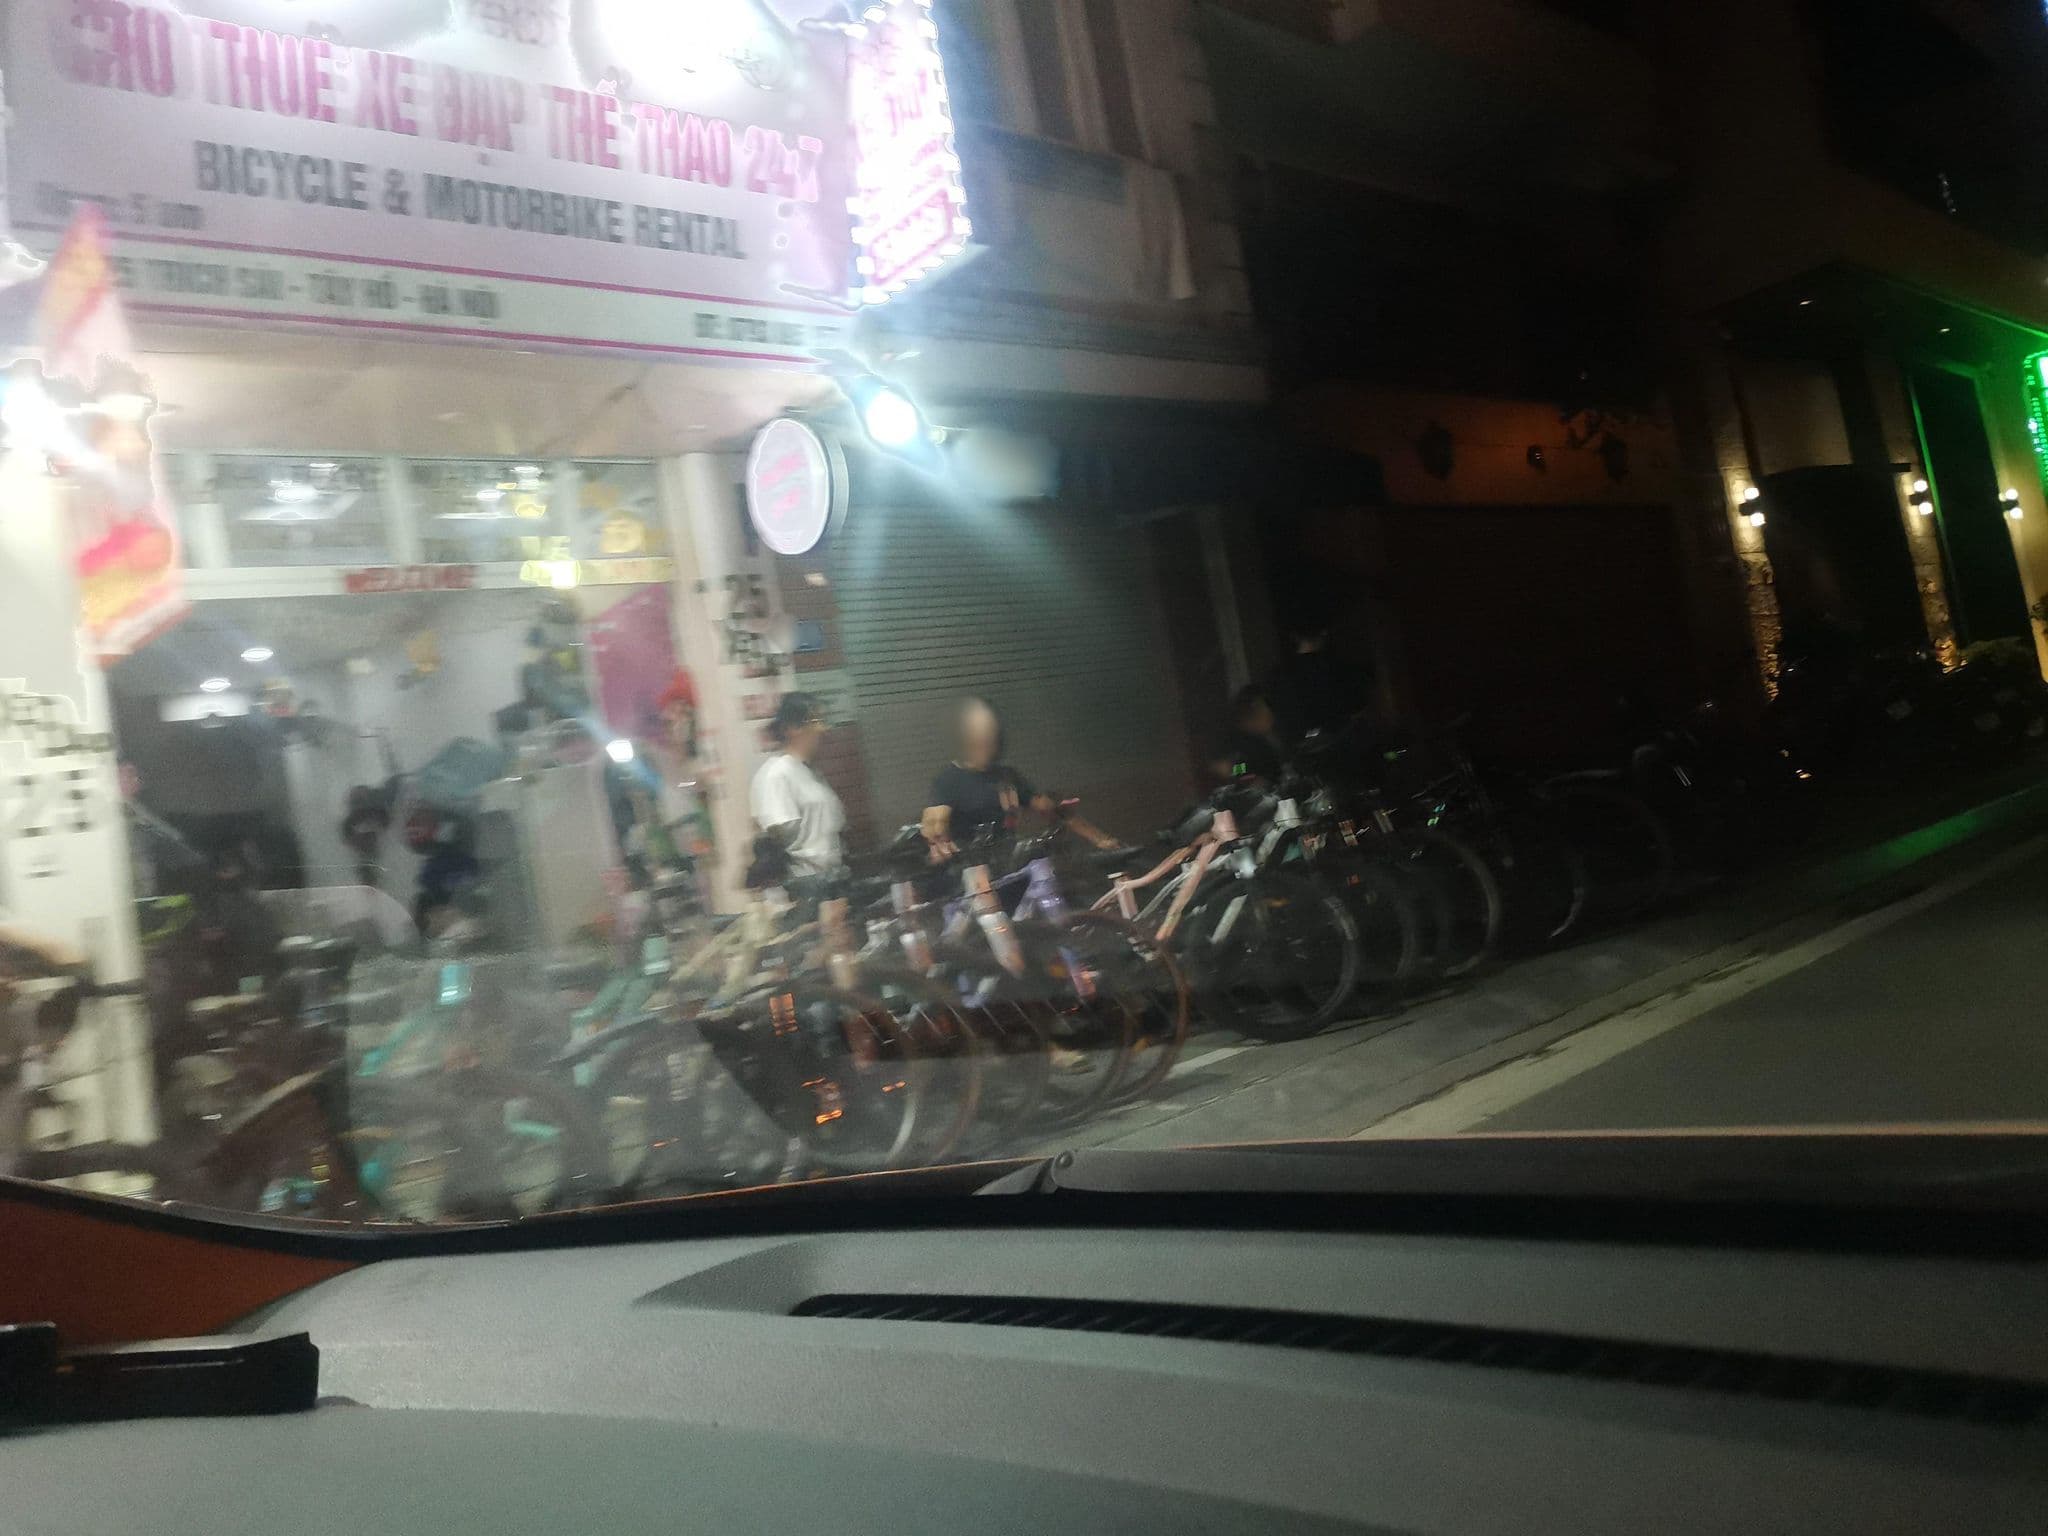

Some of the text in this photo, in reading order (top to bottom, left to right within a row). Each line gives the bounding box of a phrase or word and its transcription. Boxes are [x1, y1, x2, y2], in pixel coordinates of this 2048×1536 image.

[356, 50, 419, 136] XE
[631, 101, 731, 188] THAO
[195, 140, 369, 211] BICYCLE
[384, 167, 411, 217] &
[422, 172, 626, 244] MOTORBIKE
[632, 203, 747, 260] RENTAL
